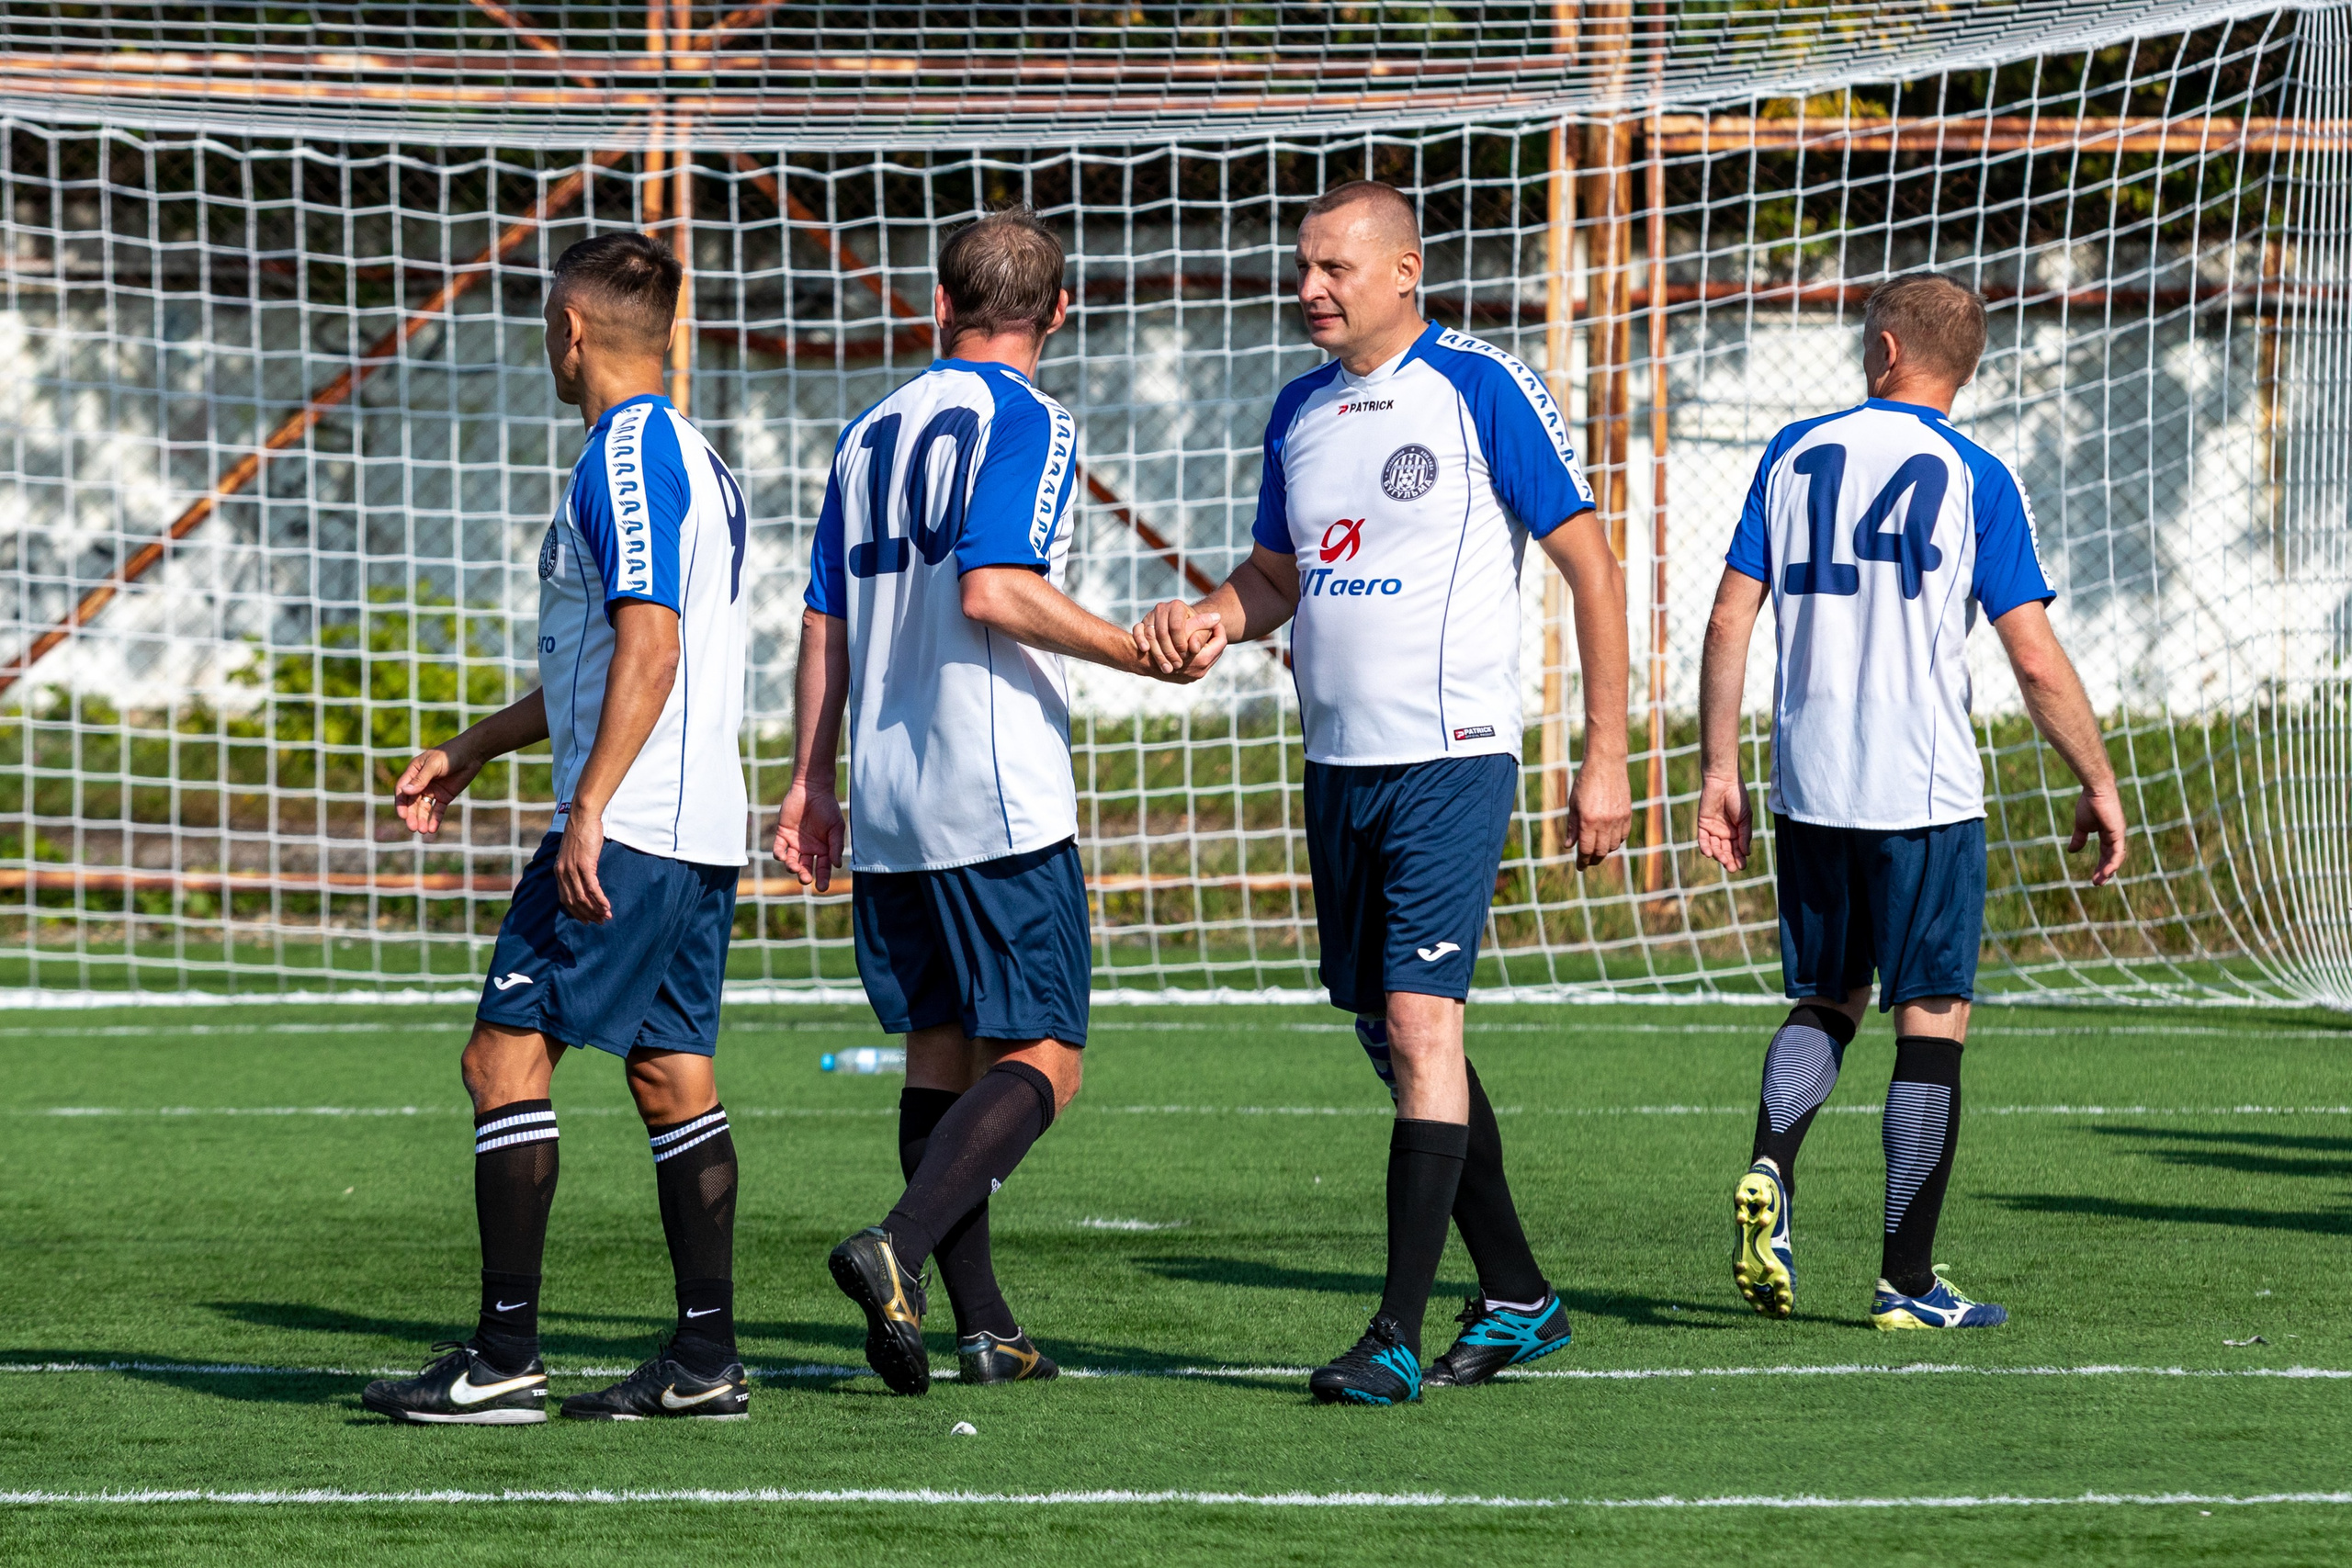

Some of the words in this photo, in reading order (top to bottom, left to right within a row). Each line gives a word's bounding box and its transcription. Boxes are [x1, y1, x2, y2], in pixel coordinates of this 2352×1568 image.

[1350, 400, 1394, 413] PATRICK
[849, 406, 980, 579] 10
[1384, 479, 1433, 499] БУГУЛЬМА
[1783, 443, 1949, 600] 14
[1464, 727, 1493, 736] PATRICK
